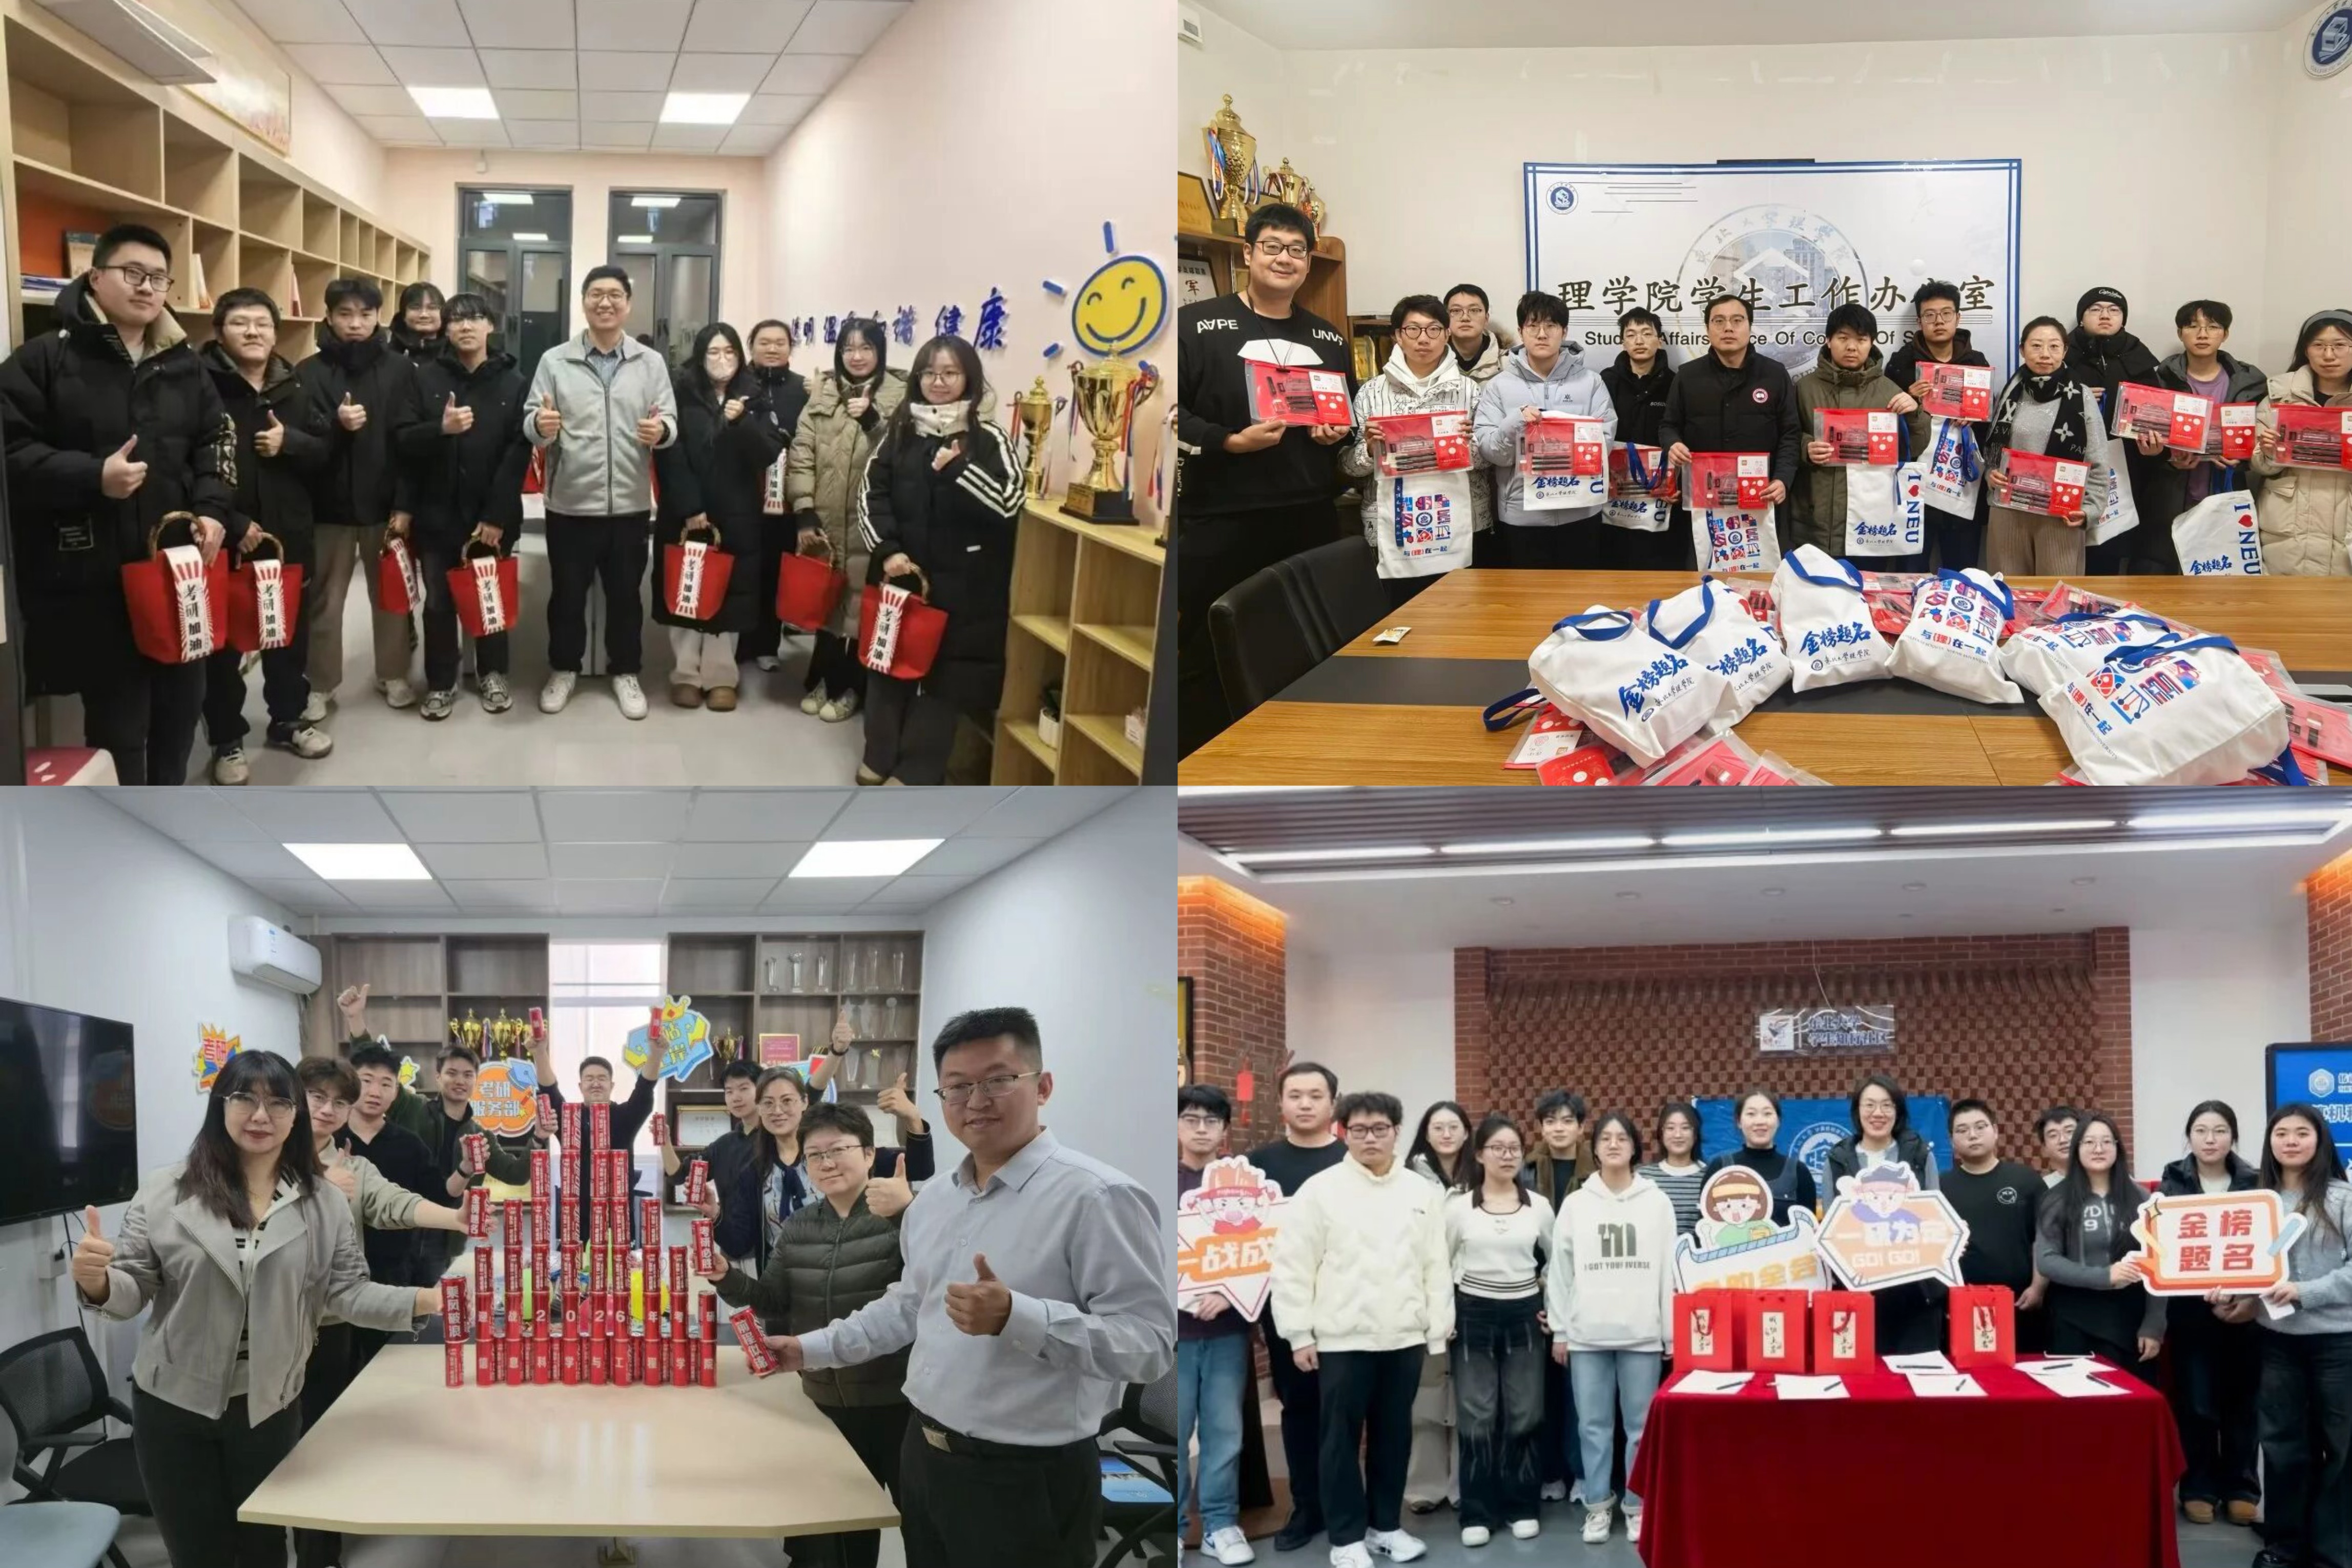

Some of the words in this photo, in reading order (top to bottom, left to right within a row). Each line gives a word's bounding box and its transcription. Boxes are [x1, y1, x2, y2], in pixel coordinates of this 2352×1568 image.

[1558, 275, 1995, 315] 理学院学生工作办室
[1585, 331, 1623, 345] Stud
[1775, 331, 1795, 345] Of
[1531, 476, 1581, 488] 金榜题名
[1853, 521, 1897, 537] 金榜题名
[1905, 500, 1921, 544] NEU
[2189, 554, 2233, 575] 金榜题名
[2238, 531, 2262, 575] NEU
[184, 584, 203, 652] 考研加油
[263, 583, 278, 638] 考研加油
[1706, 637, 1768, 676] 榜题名
[1799, 621, 1872, 657] 金榜题名
[1618, 652, 1689, 721] 金榜题名
[2177, 1209, 2253, 1240] 金榜
[1851, 1249, 1884, 1268] GO!
[1888, 1248, 1921, 1266] GO!
[2179, 1243, 2255, 1273] 题名
